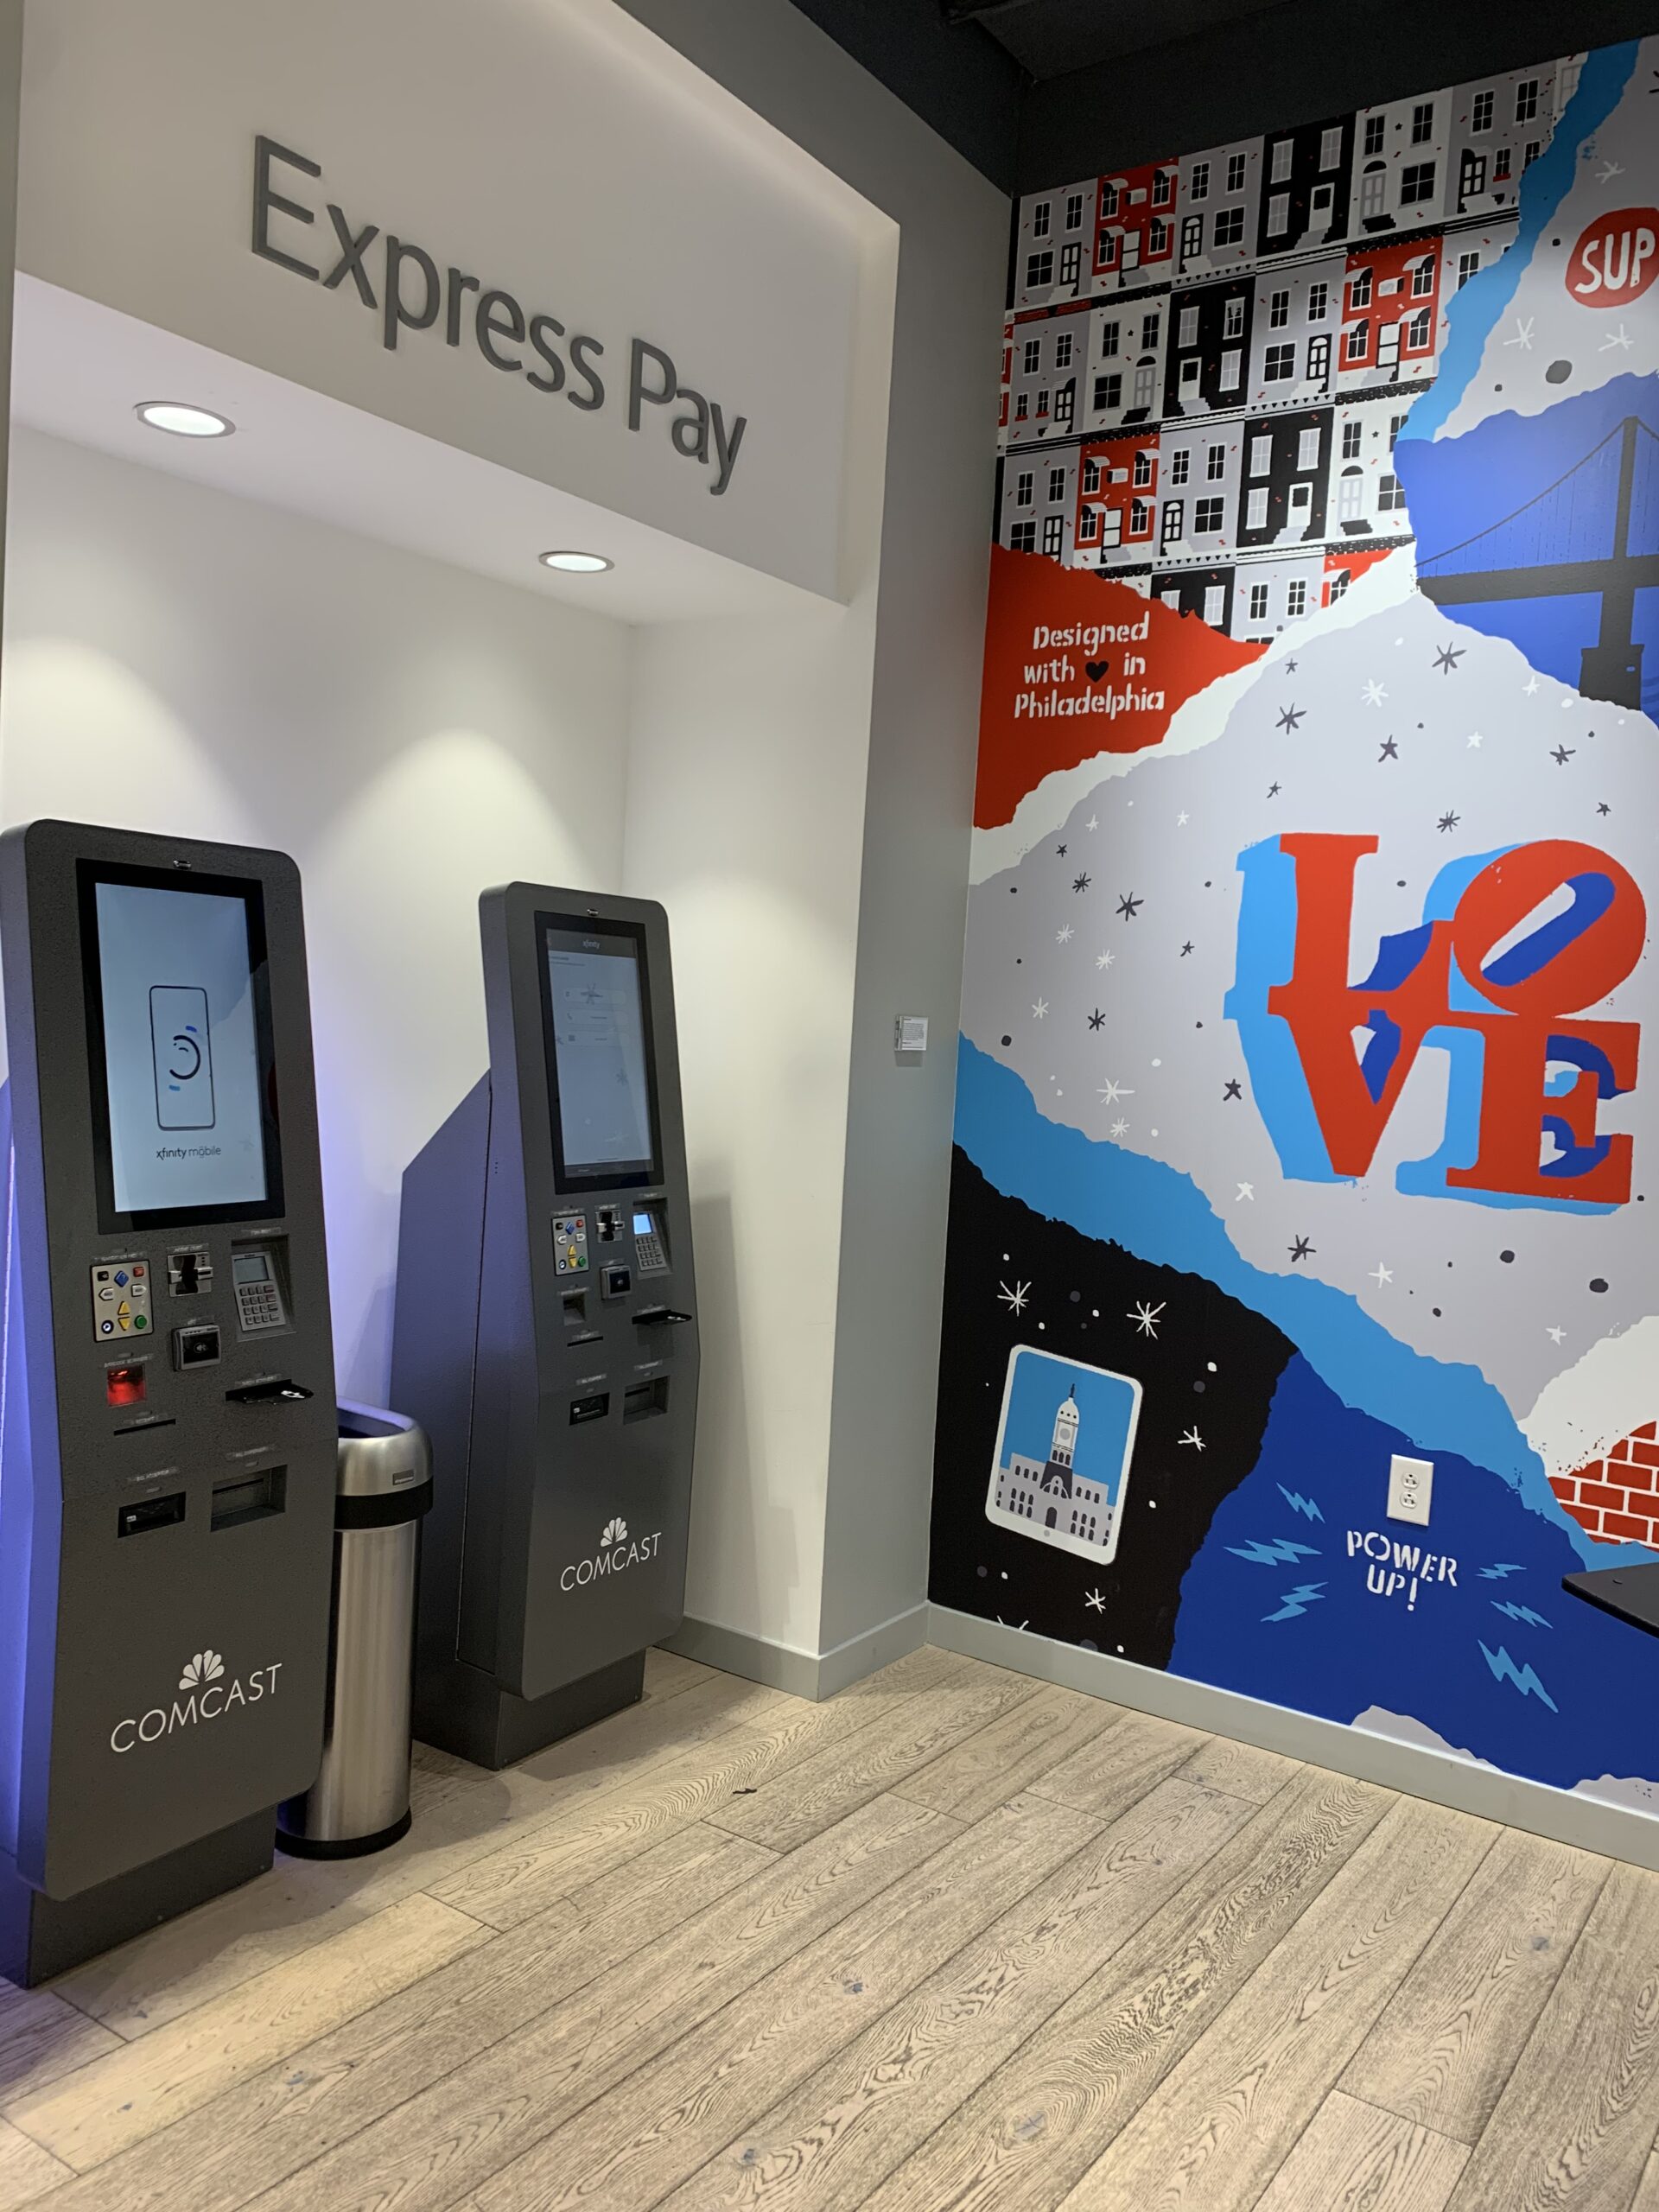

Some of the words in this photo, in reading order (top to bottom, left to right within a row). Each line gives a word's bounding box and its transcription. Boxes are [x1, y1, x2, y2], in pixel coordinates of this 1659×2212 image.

[1574, 227, 1656, 294] SUP
[252, 135, 604, 410] Express
[628, 338, 747, 495] Pay
[1033, 610, 1150, 657] Designed
[1024, 654, 1075, 684] with
[1123, 652, 1146, 677] in
[1014, 683, 1165, 721] Philadelphia
[156, 1147, 188, 1161] xfinity
[188, 1145, 222, 1159] mobile
[560, 1531, 662, 1592] COMCAST
[1346, 1529, 1458, 1587] POWER
[1366, 1563, 1418, 1611] UP!
[110, 1662, 283, 1753] COMCAST
